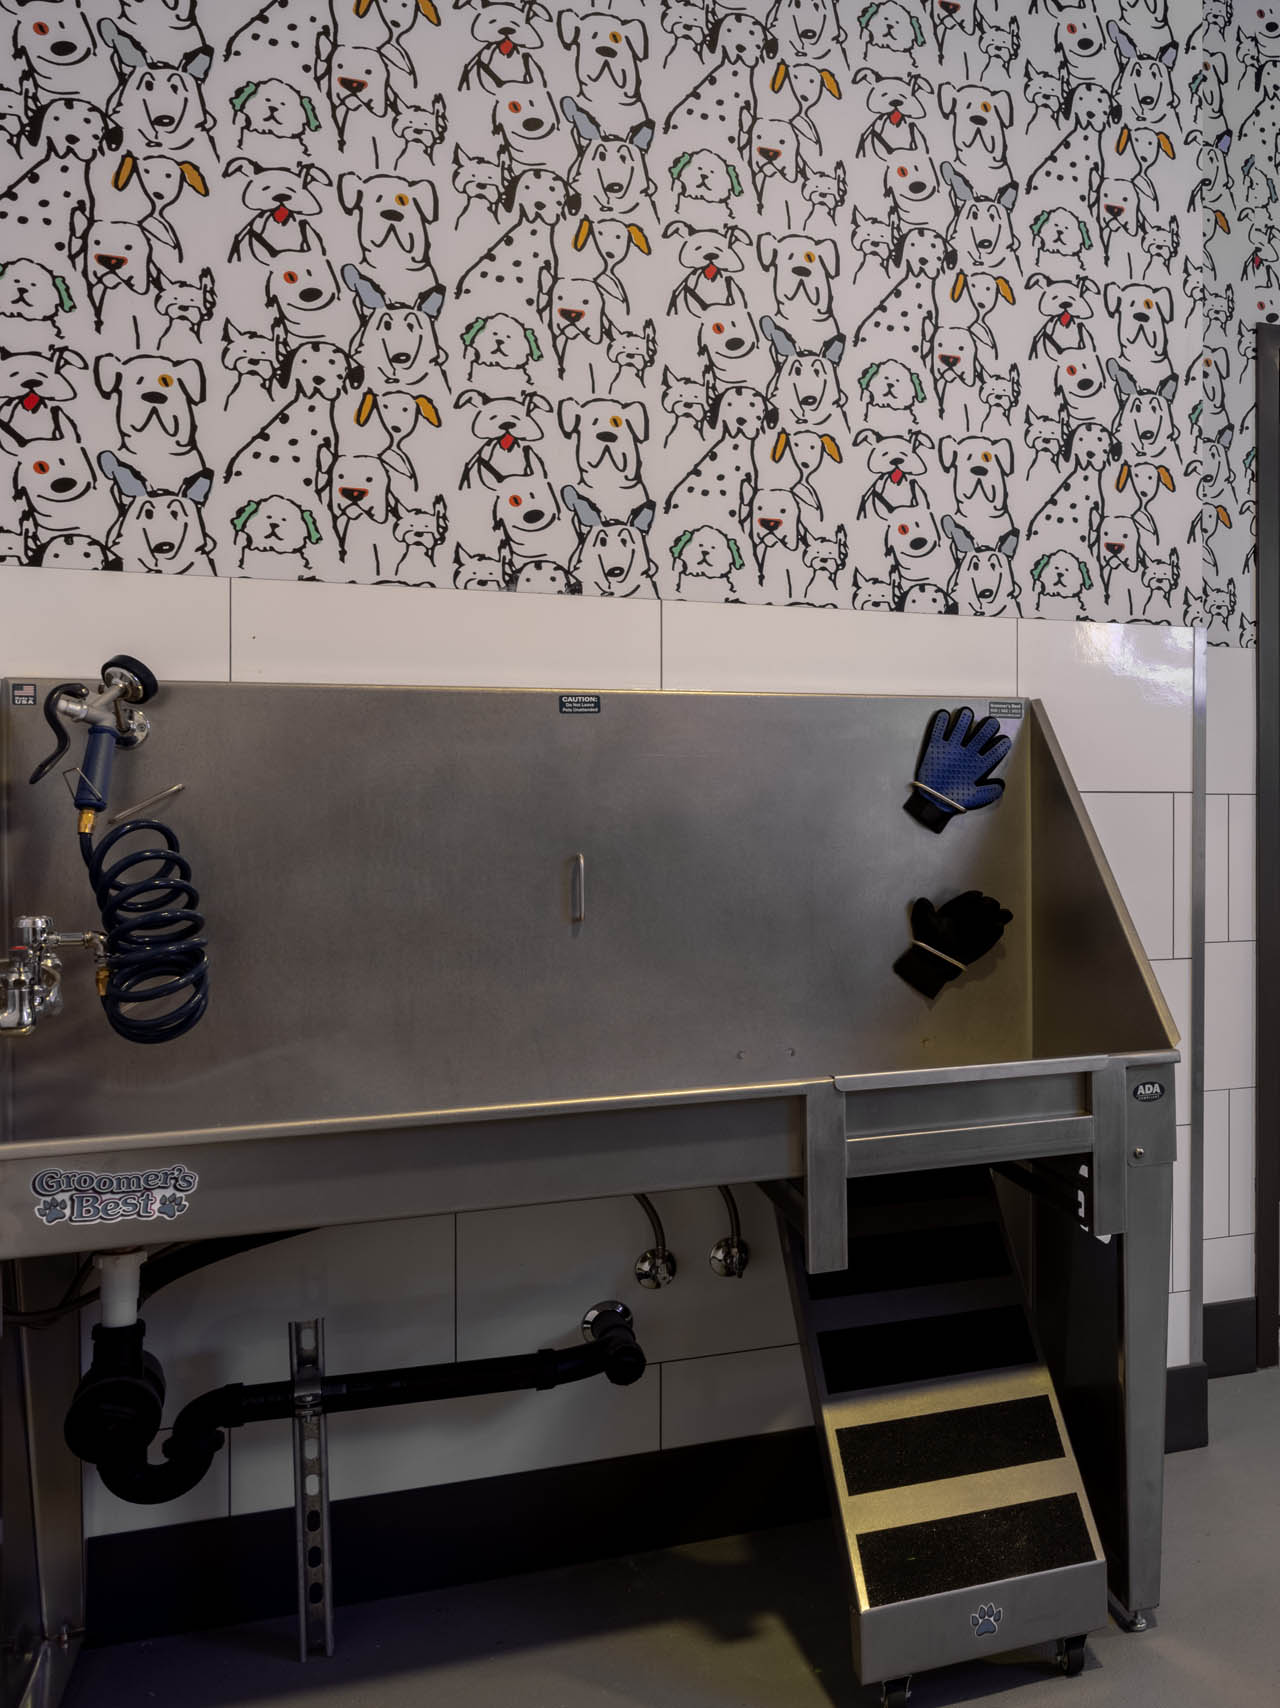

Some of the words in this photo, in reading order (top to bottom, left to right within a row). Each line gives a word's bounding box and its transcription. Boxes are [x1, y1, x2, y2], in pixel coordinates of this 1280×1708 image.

[1137, 1083, 1161, 1095] ADA
[33, 1165, 197, 1196] Groomer's
[71, 1191, 156, 1223] Best
